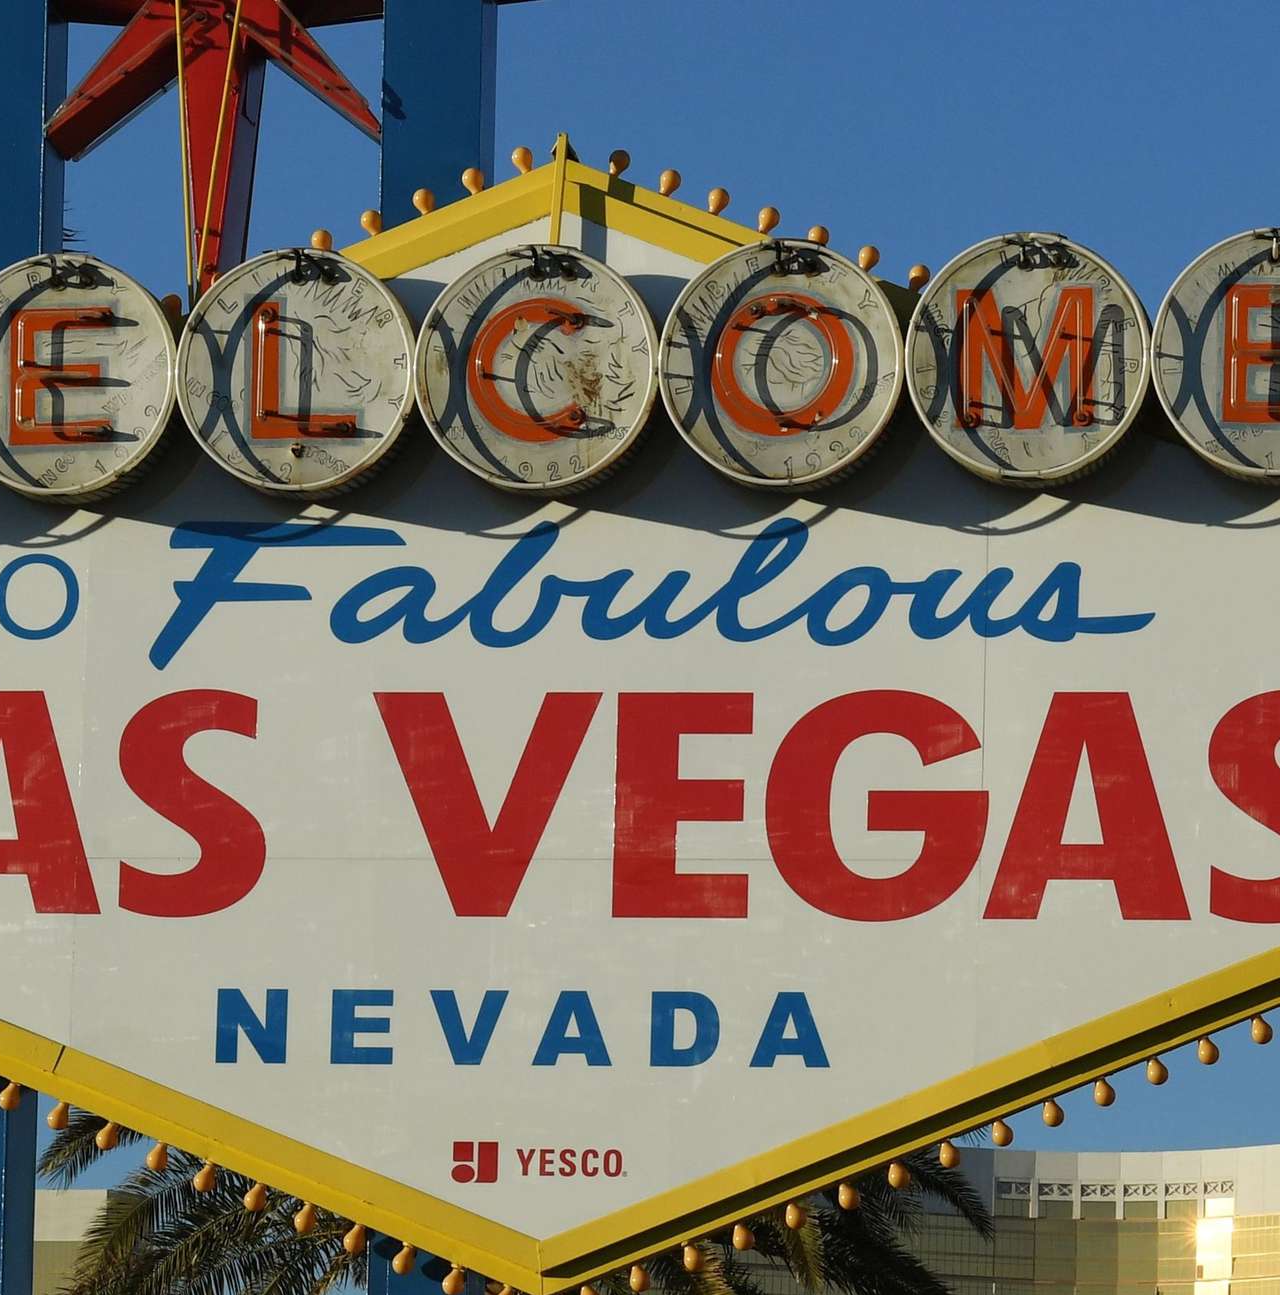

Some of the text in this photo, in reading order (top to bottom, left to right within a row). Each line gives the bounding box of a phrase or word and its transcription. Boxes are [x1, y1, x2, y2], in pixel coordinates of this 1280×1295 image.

[150, 519, 1154, 668] Fabulous
[217, 989, 828, 1067] NEVADA
[516, 1149, 624, 1177] YESCO
